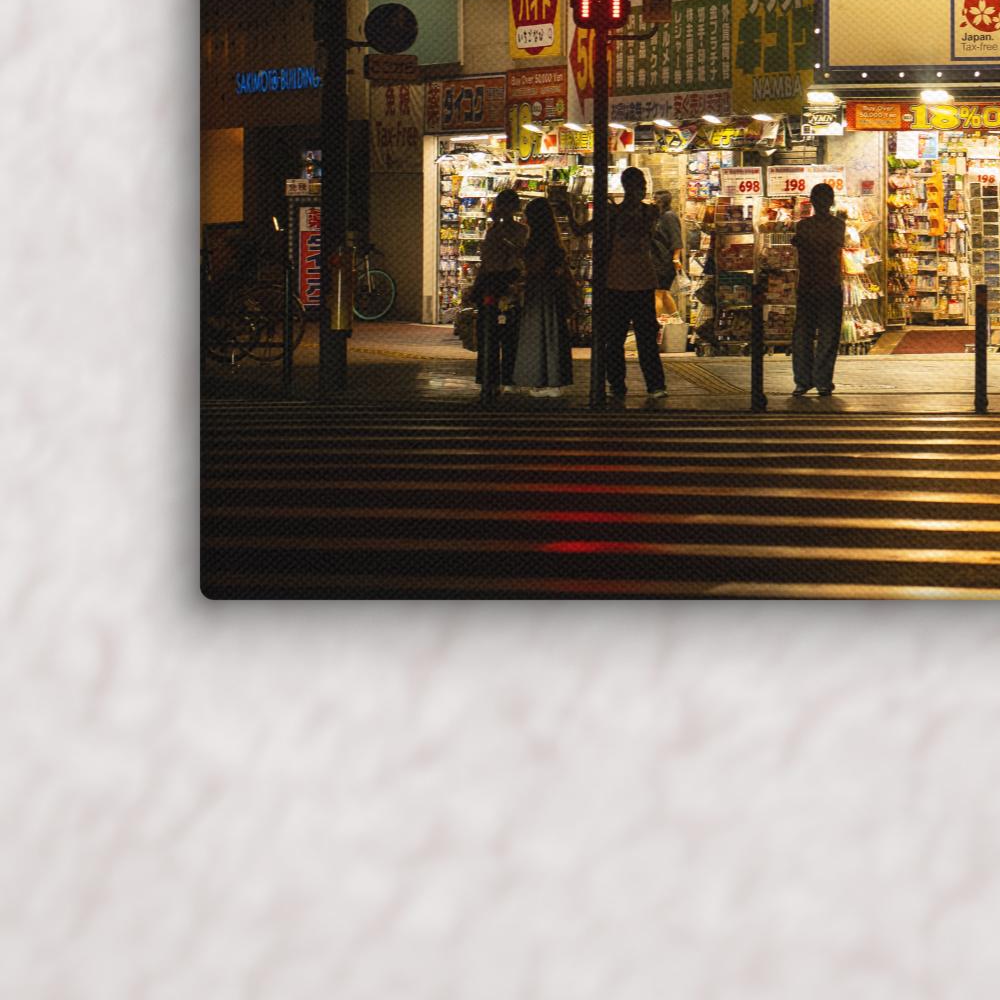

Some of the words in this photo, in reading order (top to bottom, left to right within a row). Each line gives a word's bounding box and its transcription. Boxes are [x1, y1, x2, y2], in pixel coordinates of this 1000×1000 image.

[961, 42, 998, 51] Tax-free
[753, 75, 802, 101] NAMBA
[738, 181, 760, 192] 698
[783, 179, 806, 192] 198
